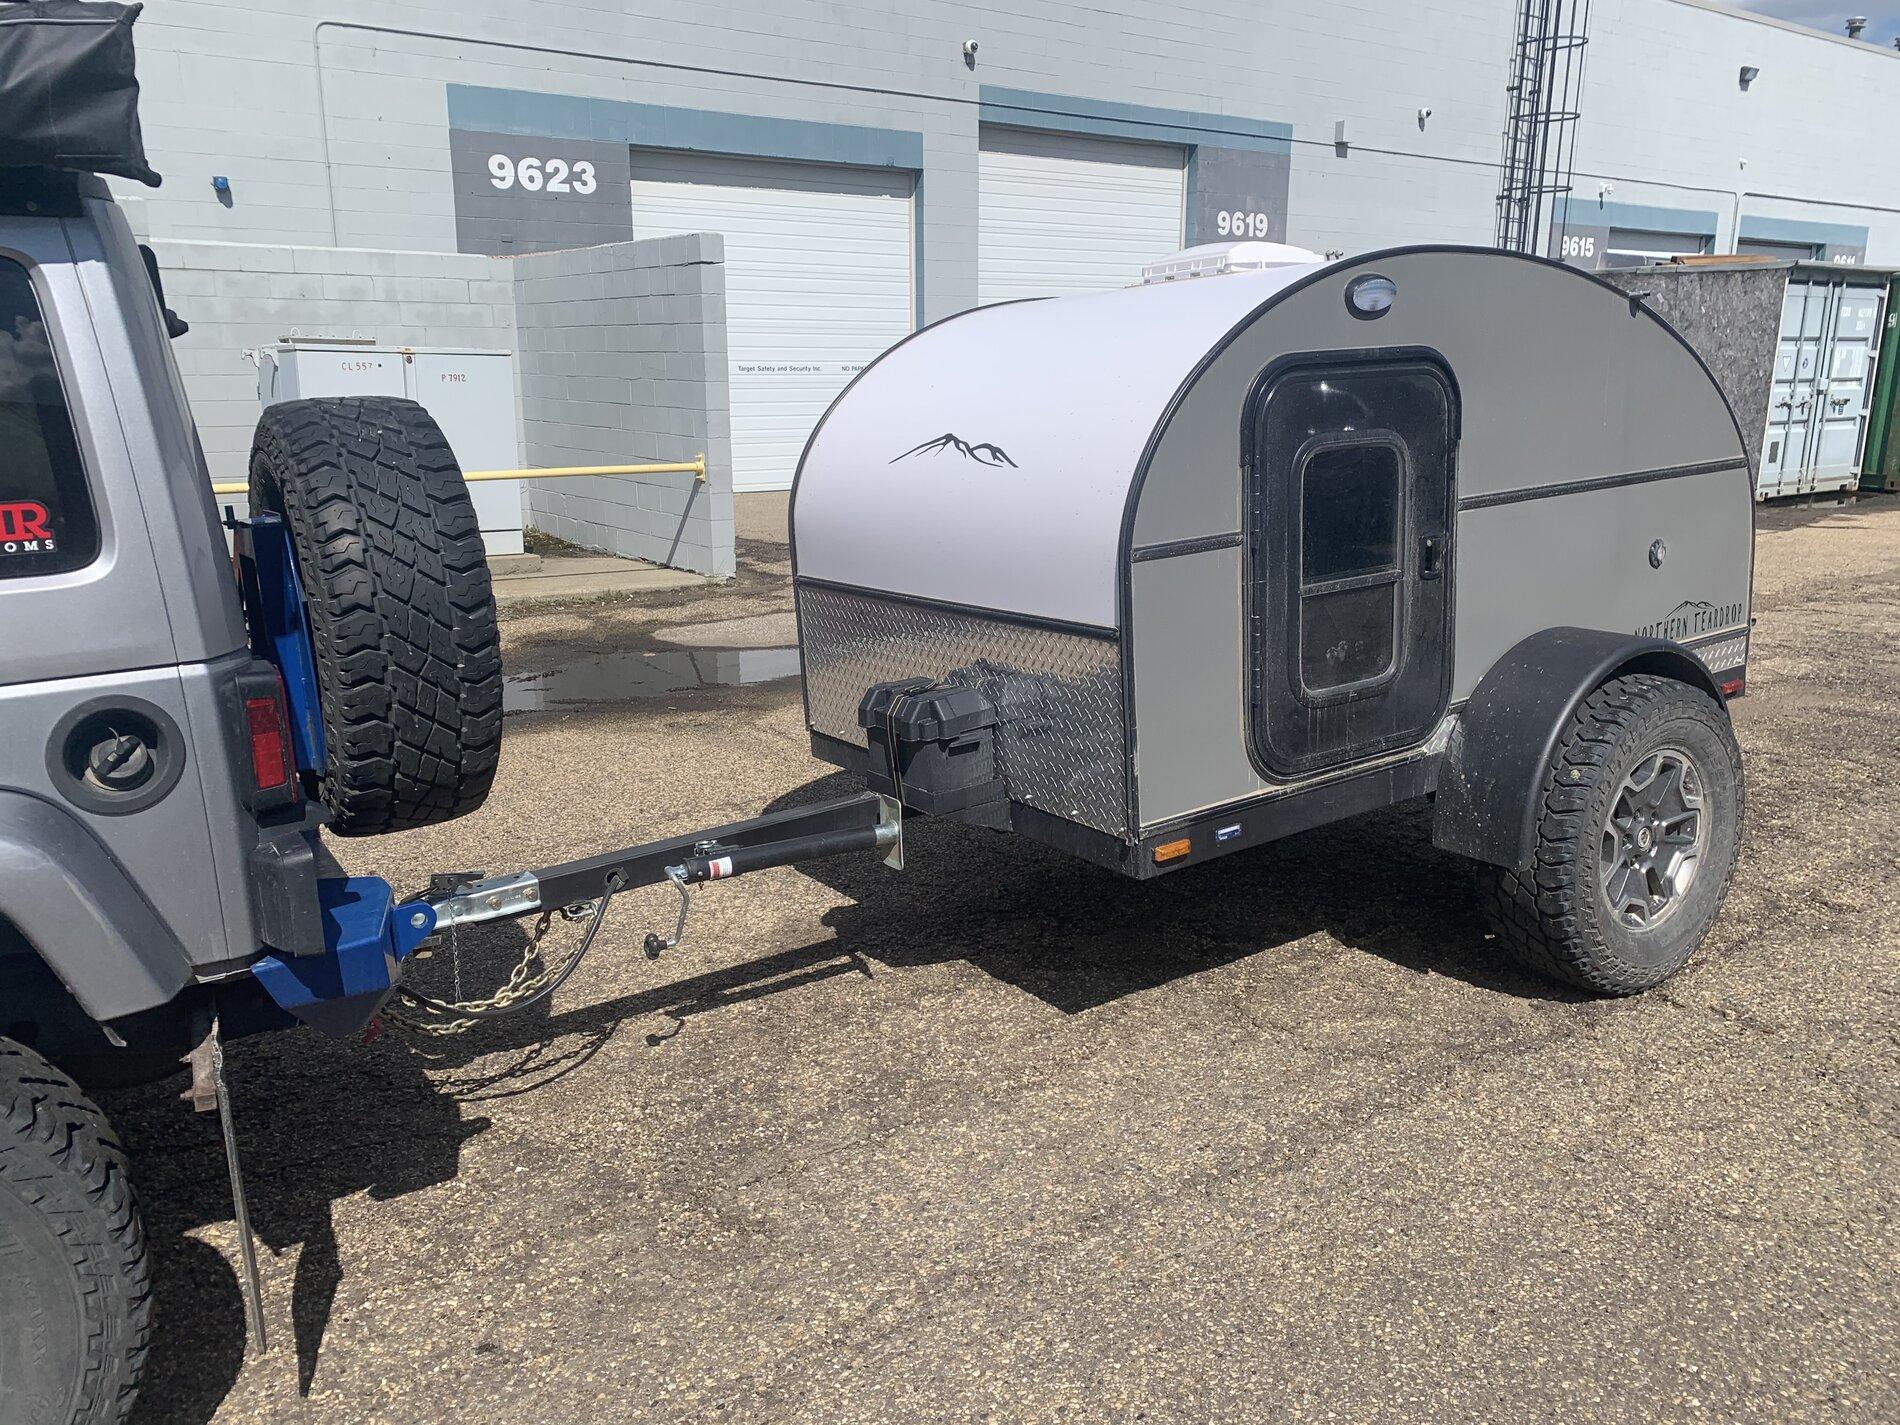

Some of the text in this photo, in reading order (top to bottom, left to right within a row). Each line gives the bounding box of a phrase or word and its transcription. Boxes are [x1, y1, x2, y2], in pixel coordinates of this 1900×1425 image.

[487, 153, 597, 195] 9623
[1217, 210, 1268, 238] 9619
[1561, 235, 1595, 258] 9615
[449, 374, 466, 383] 7912
[738, 365, 756, 373] Target
[757, 365, 775, 373] Safety
[789, 365, 811, 373] Security
[1694, 602, 1743, 633] TEARDROP
